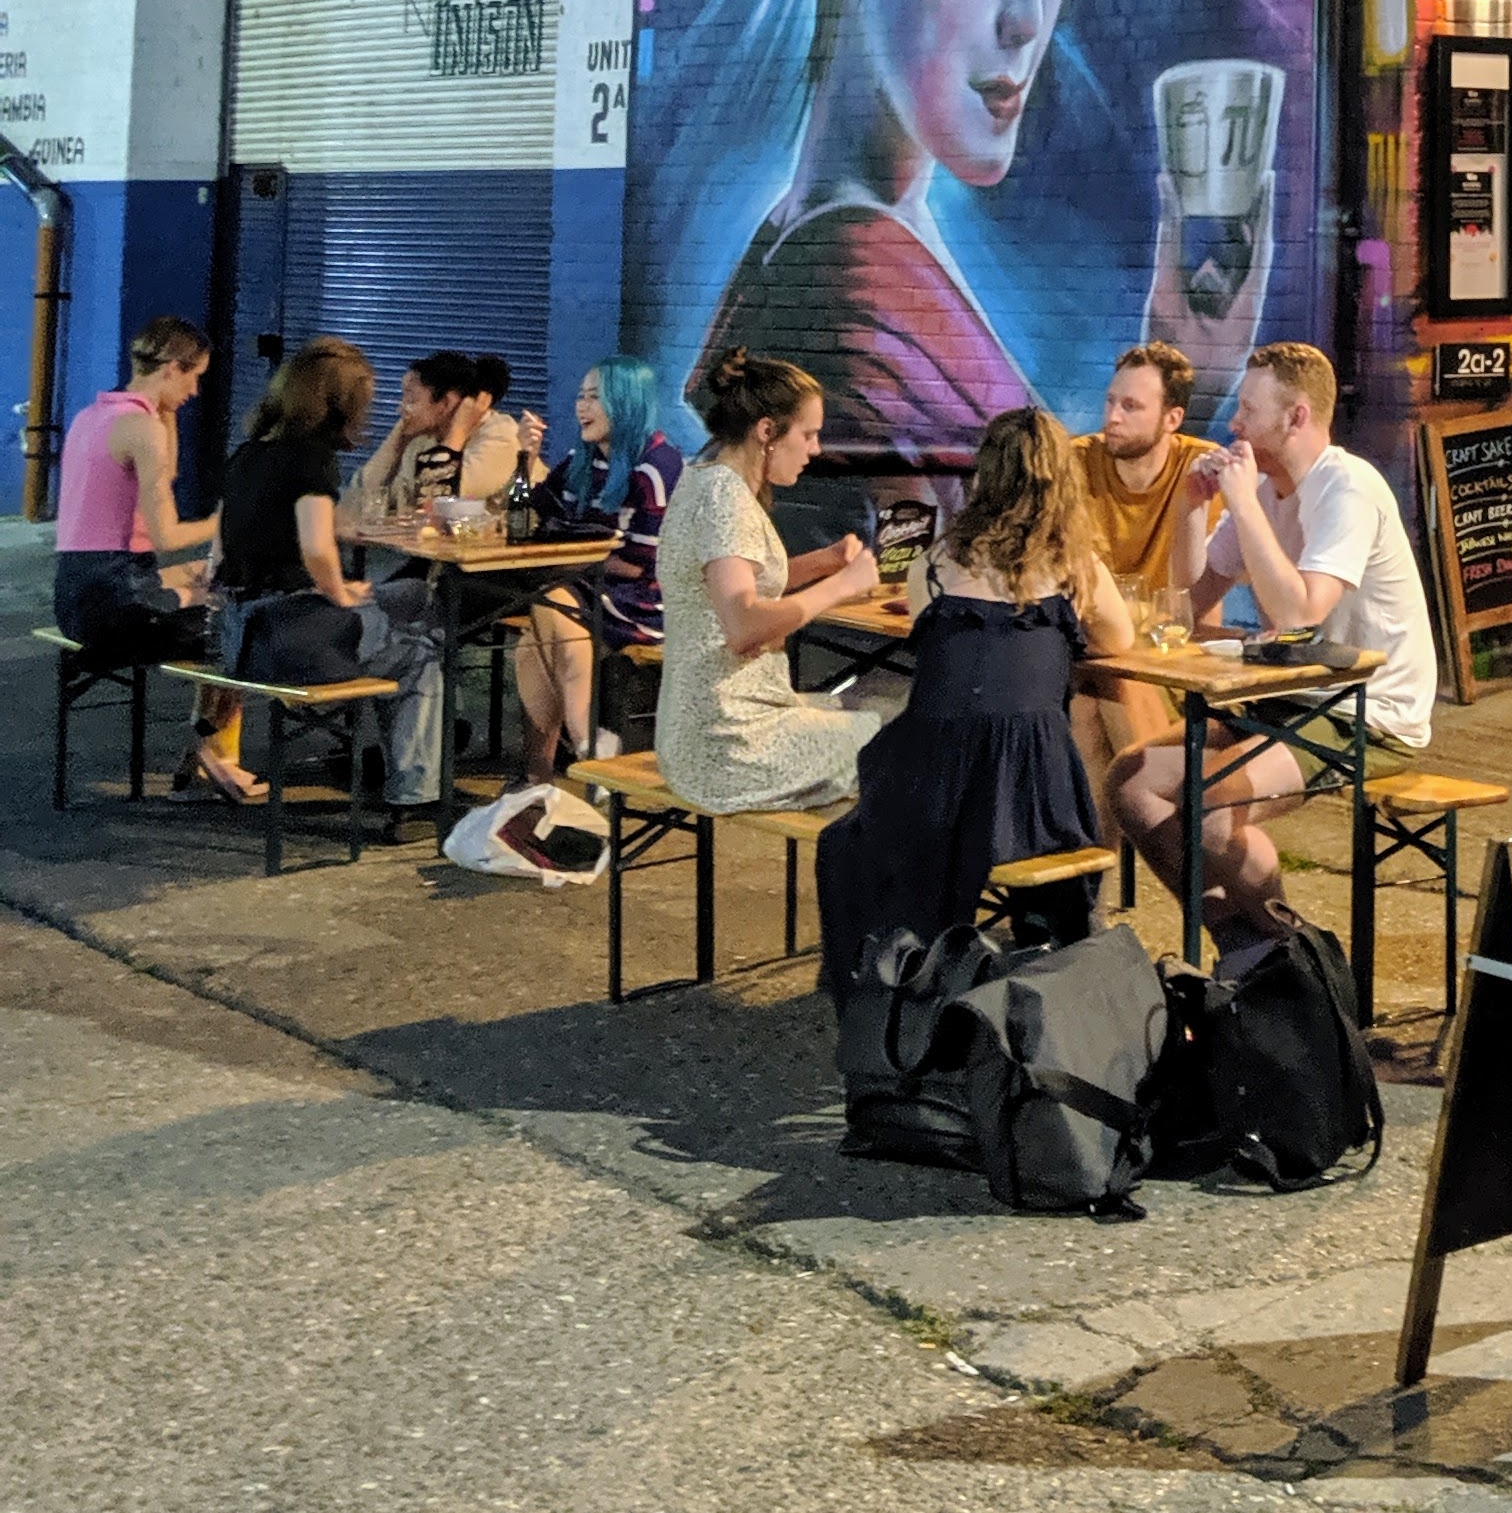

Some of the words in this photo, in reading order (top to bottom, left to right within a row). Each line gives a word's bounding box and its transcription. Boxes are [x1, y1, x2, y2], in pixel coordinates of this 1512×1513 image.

[587, 40, 632, 72] UNIT
[0, 93, 46, 122] AMBIA
[1457, 348, 1505, 374] 2a-2
[1445, 443, 1480, 469] CRAFT
[1481, 435, 1512, 462] SAKE
[1454, 509, 1483, 527] CRAFT
